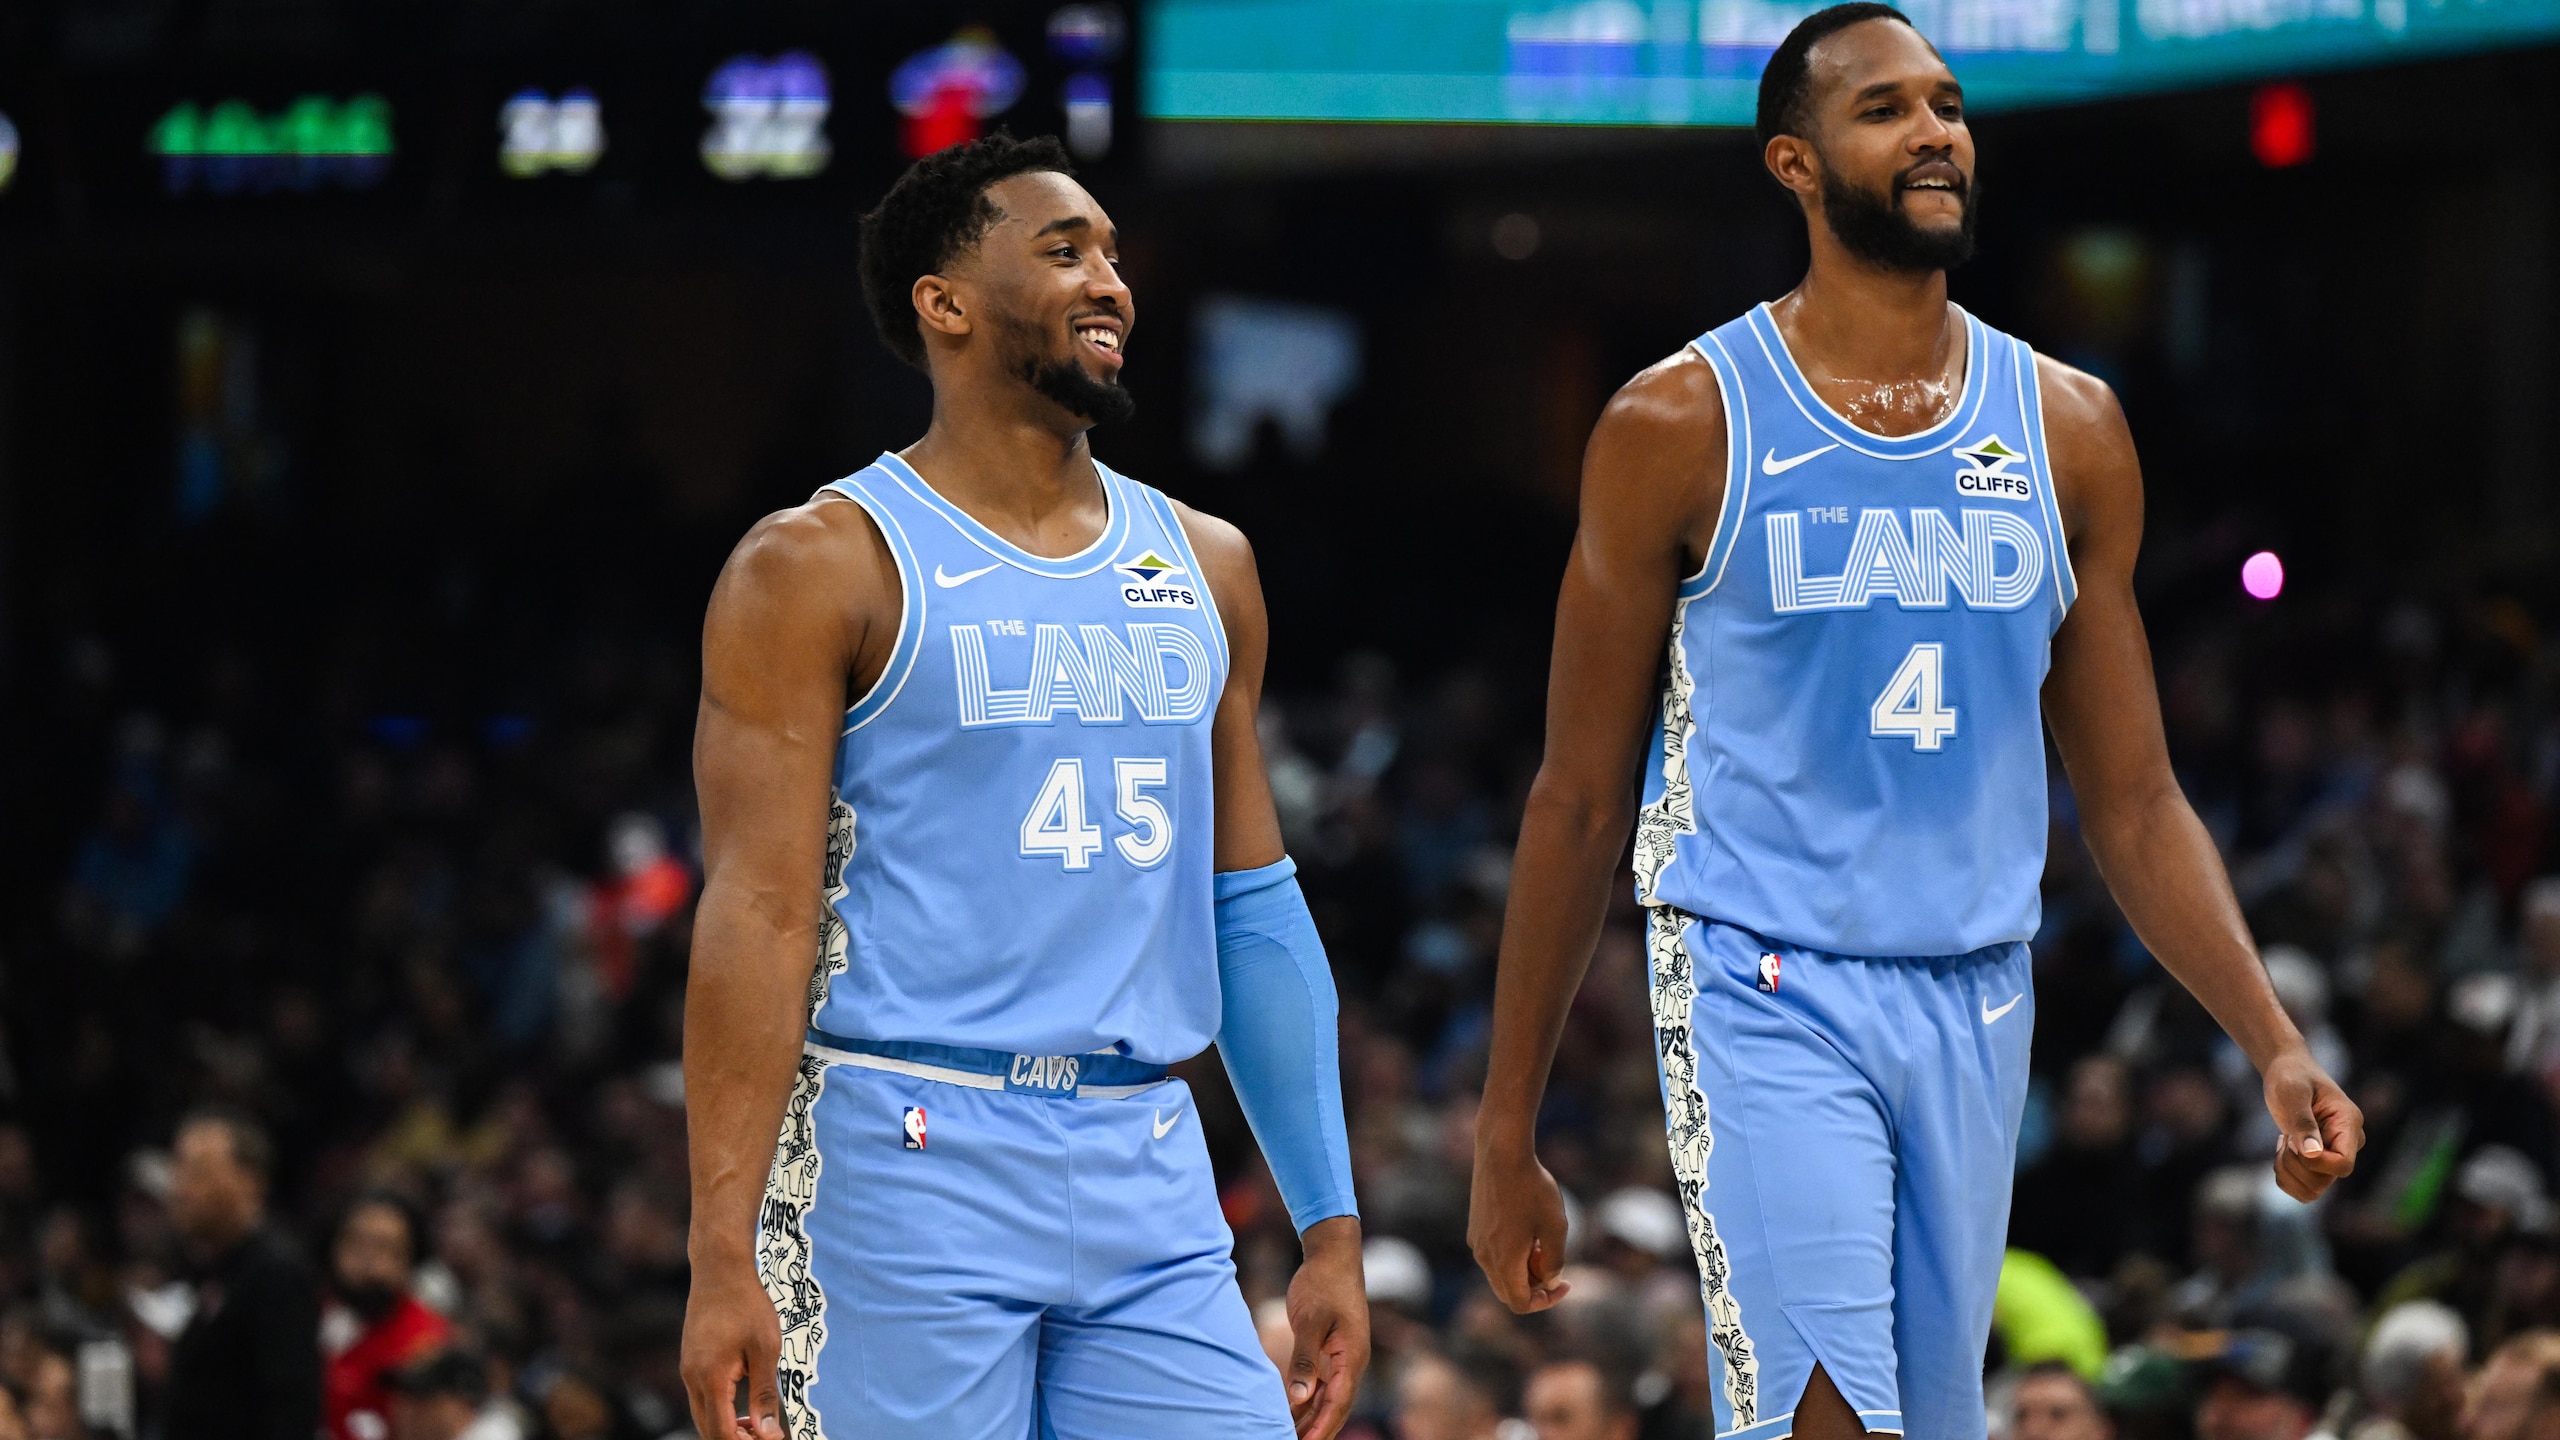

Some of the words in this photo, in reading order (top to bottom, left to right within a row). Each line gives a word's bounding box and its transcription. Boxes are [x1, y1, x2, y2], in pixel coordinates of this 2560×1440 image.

[1959, 474, 2029, 495] CLIFFS
[1807, 506, 1849, 524] THE
[1766, 508, 2044, 613] LAND
[1124, 588, 1194, 605] CLIFFS
[986, 619, 1028, 636] THE
[949, 622, 1212, 726] LAND
[1870, 643, 1957, 750] 4
[1019, 757, 1173, 870] 45
[1010, 1053, 1079, 1091] CAVS
